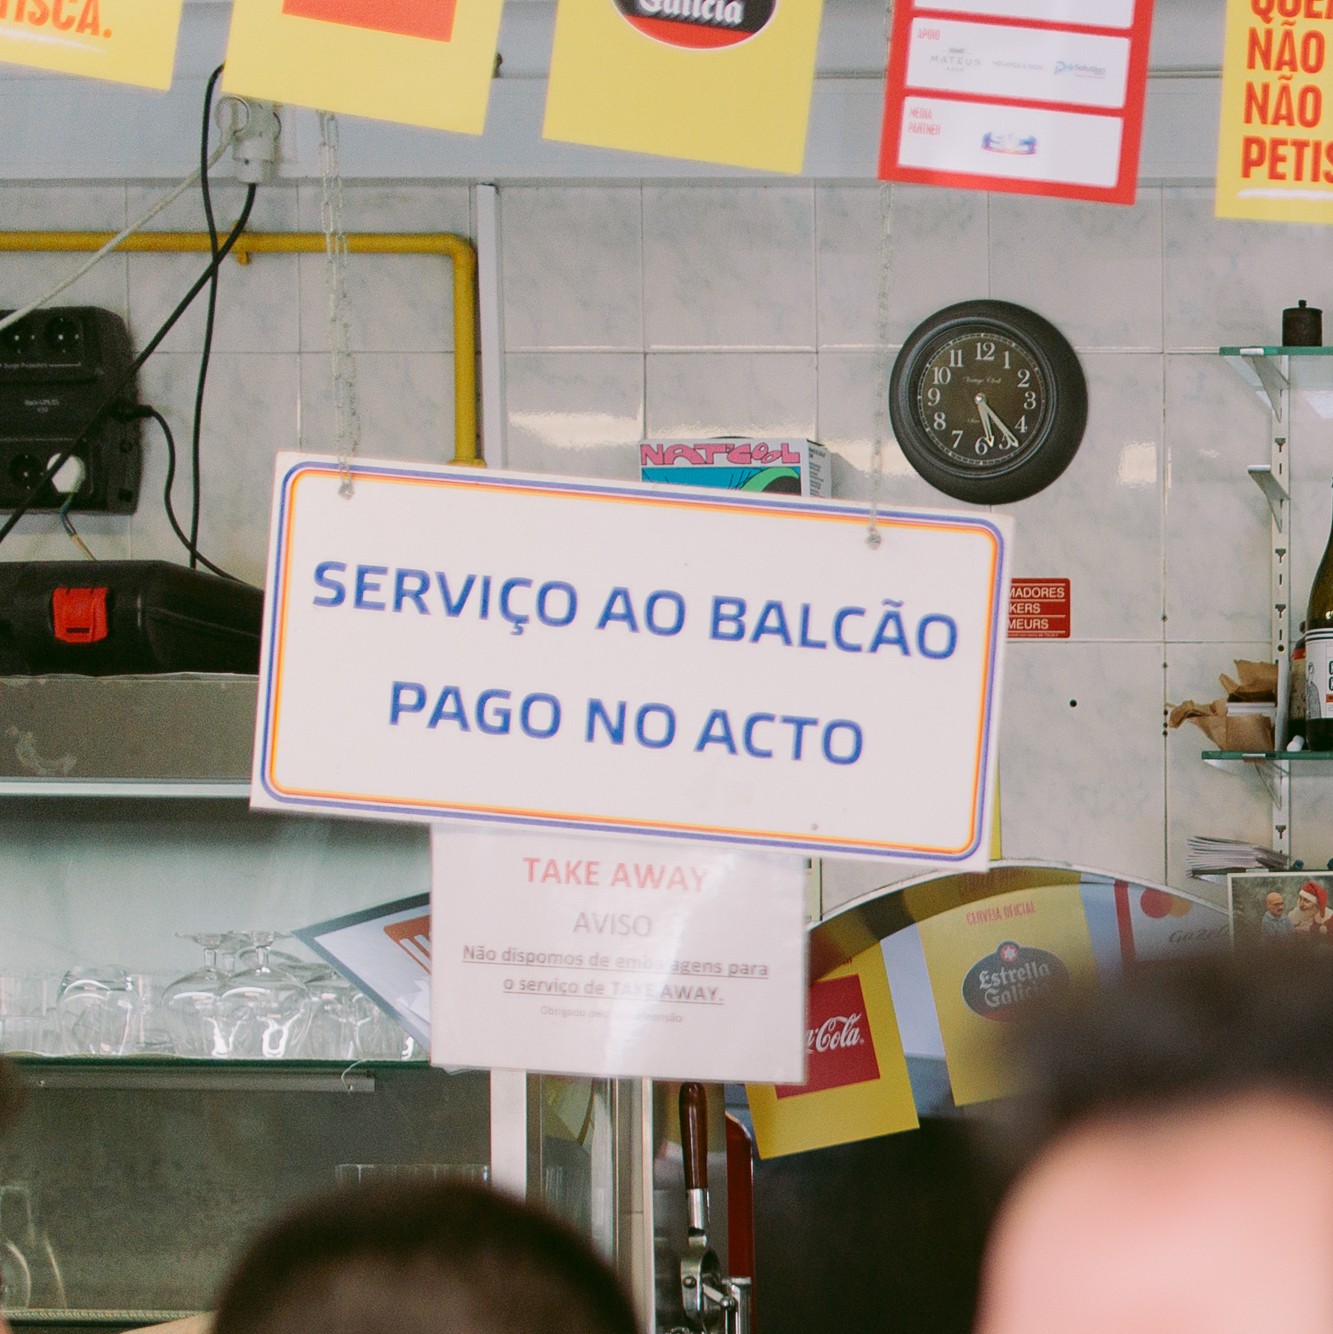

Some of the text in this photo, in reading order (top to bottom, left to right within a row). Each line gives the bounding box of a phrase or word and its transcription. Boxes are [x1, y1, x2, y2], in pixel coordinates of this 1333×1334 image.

[1246, 18, 1326, 74] NÃO
[1243, 74, 1323, 128] NÃO
[949, 349, 964, 368] 11
[974, 342, 995, 361] 12
[1003, 350, 1011, 369] 1
[932, 366, 951, 385] 10
[1017, 369, 1031, 388] 2
[927, 388, 941, 407] 9
[1023, 391, 1037, 410] 3
[933, 411, 947, 431] 8
[1015, 415, 1028, 434] 4
[951, 430, 964, 449] 7
[975, 437, 989, 456] 6
[313, 560, 959, 661] SERVIÇO AO BALCÃO
[389, 680, 865, 767] PAGO NO ACTO
[523, 857, 709, 893] TAKE AWAY
[573, 911, 653, 938] AVISO
[463, 944, 497, 963] Não
[501, 946, 583, 968] dispomos
[589, 950, 610, 968] de
[728, 963, 768, 979] para
[979, 961, 1051, 989] Estrella
[503, 978, 514, 990] o
[518, 977, 578, 997] serviço
[584, 979, 605, 996] de
[660, 984, 724, 1001] AWAY.
